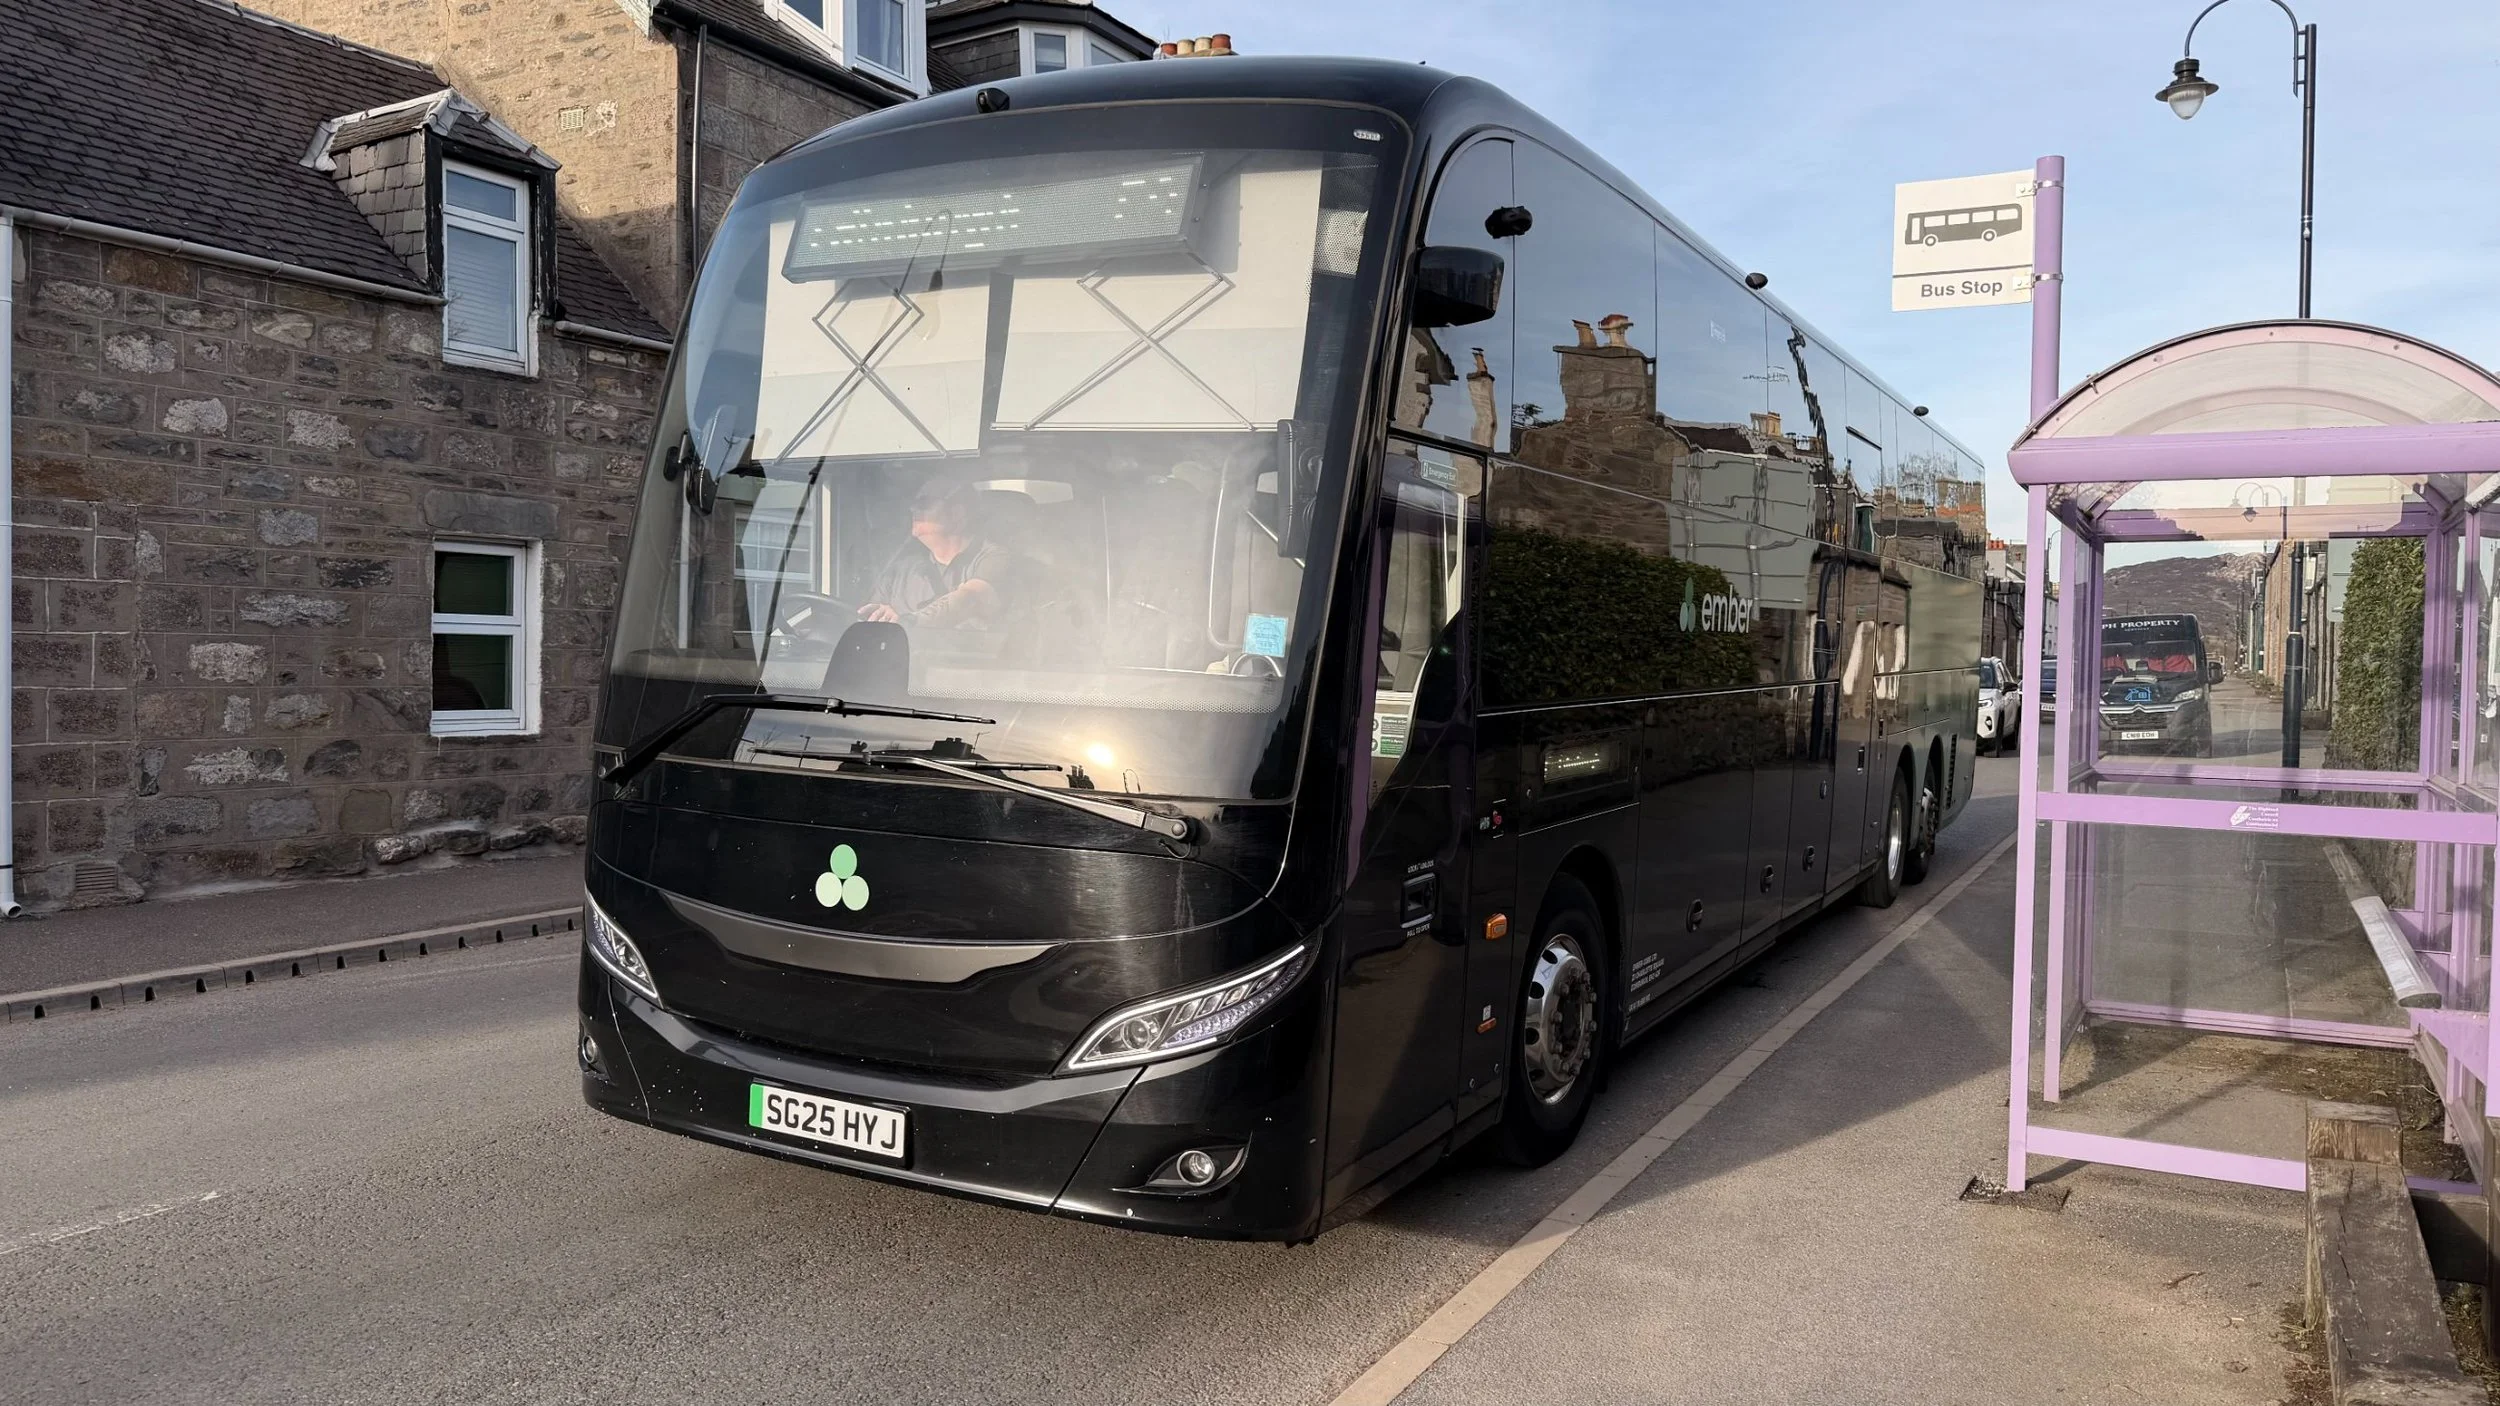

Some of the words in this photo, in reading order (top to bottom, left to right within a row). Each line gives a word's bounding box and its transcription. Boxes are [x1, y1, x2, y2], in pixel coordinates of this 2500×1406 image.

[1921, 284, 1955, 298] Bus
[1961, 280, 2003, 297] Stop
[1702, 584, 1753, 633] ember
[2120, 620, 2180, 628] PROPERTY
[767, 1094, 836, 1137] SG25
[843, 1109, 897, 1150] HYJ
